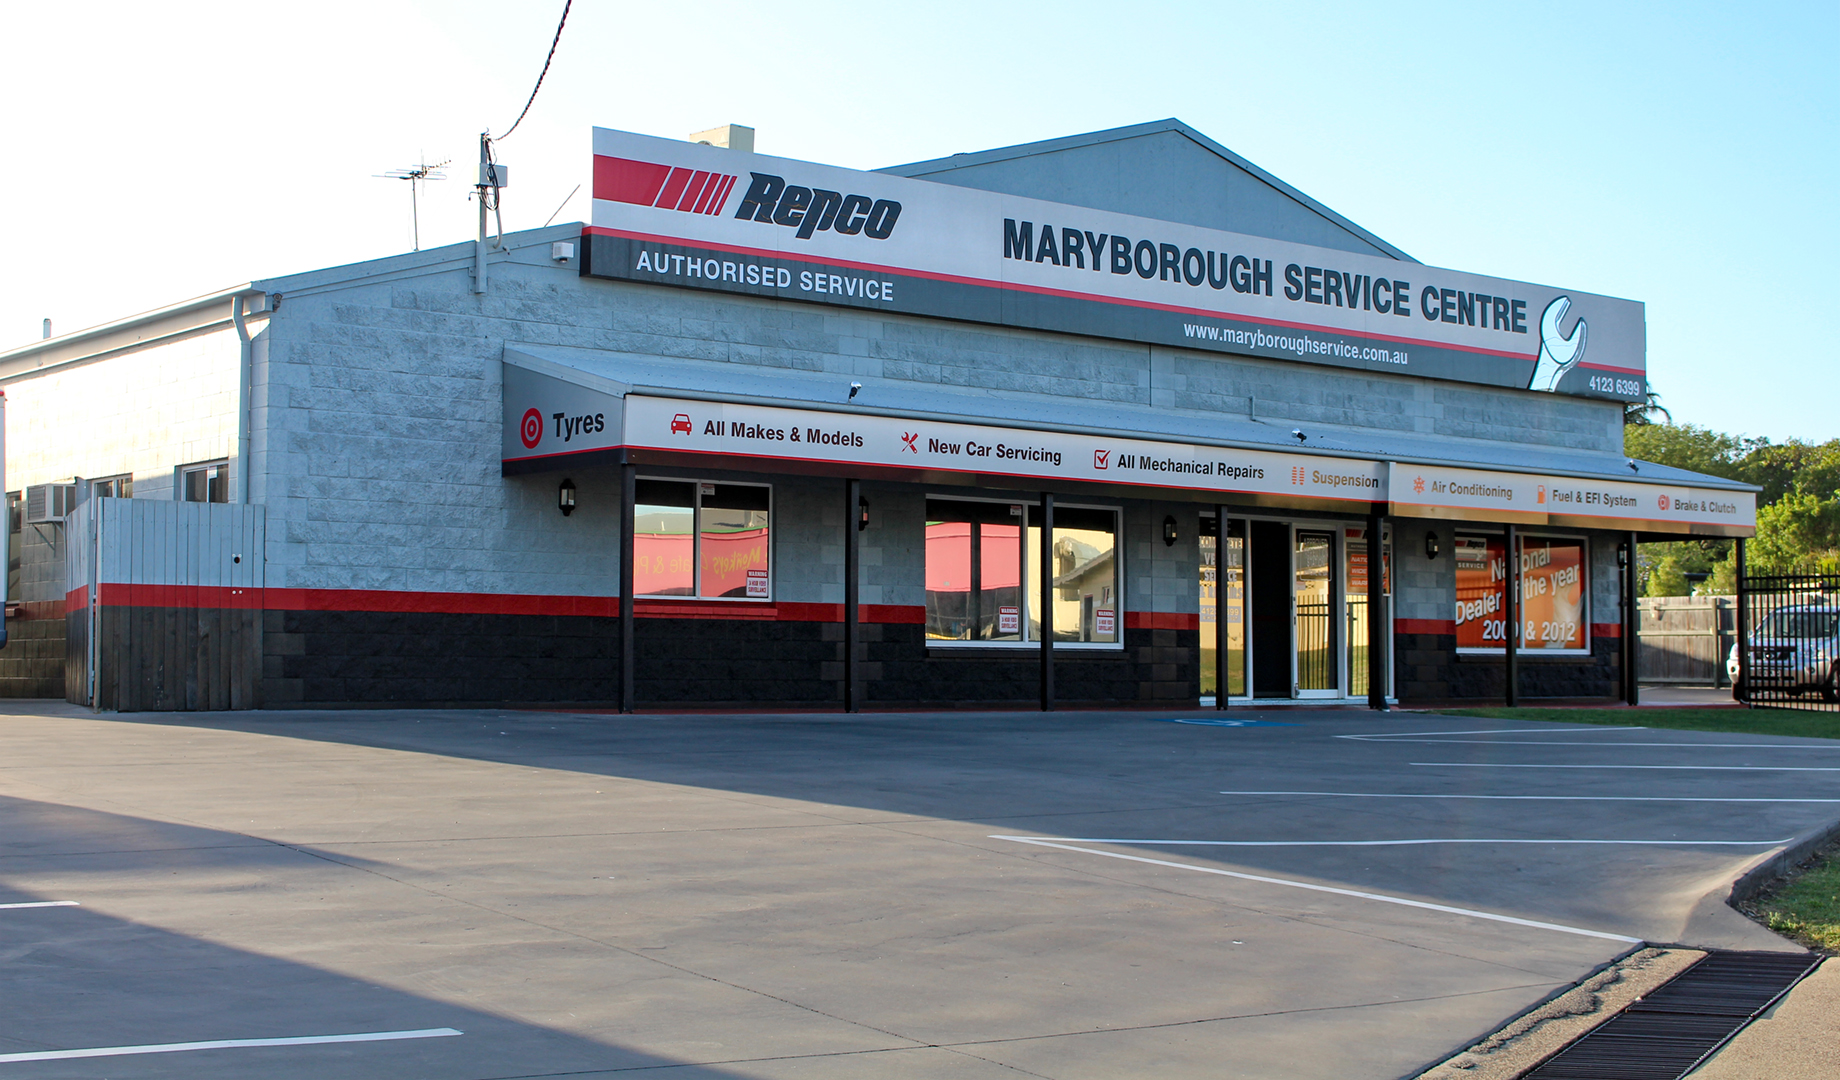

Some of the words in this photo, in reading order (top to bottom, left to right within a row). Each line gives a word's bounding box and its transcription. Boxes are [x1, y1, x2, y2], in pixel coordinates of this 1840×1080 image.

[734, 171, 902, 240] Repco
[636, 250, 791, 288] AUTHORISED
[799, 270, 894, 301] SERVICE
[1003, 217, 1273, 297] MARYBOROUGH
[1284, 263, 1411, 317] SERVICE
[1420, 285, 1528, 334] CENTRE
[1183, 322, 1408, 365] www.maryboroughservice.com.au
[1589, 375, 1614, 393] 4123
[1615, 378, 1640, 396] 6399
[552, 412, 605, 442] Tyres
[703, 420, 725, 436] All
[731, 421, 785, 441] Makes
[789, 426, 801, 442] &
[806, 428, 864, 447] Models
[928, 438, 961, 455] New
[966, 441, 992, 457] Car
[996, 443, 1062, 466] Servicing
[1117, 454, 1135, 469] All
[1139, 455, 1214, 475] Mechanical
[1217, 462, 1265, 480] Repairs
[1311, 469, 1379, 488] Suspension
[1431, 480, 1447, 493] Air
[1449, 482, 1513, 501] Conditioning
[1552, 489, 1573, 503] Fuel
[1575, 491, 1582, 503] &
[1585, 492, 1601, 504] EFI
[1603, 493, 1637, 508] System
[1674, 499, 1698, 512] Brake
[1700, 501, 1707, 512] &
[1709, 501, 1737, 514] Clutch
[1455, 592, 1502, 626] Dealer
[1524, 576, 1548, 600] the
[1550, 563, 1580, 597] year
[1525, 620, 1536, 641] &
[1541, 621, 1576, 641] 2012
